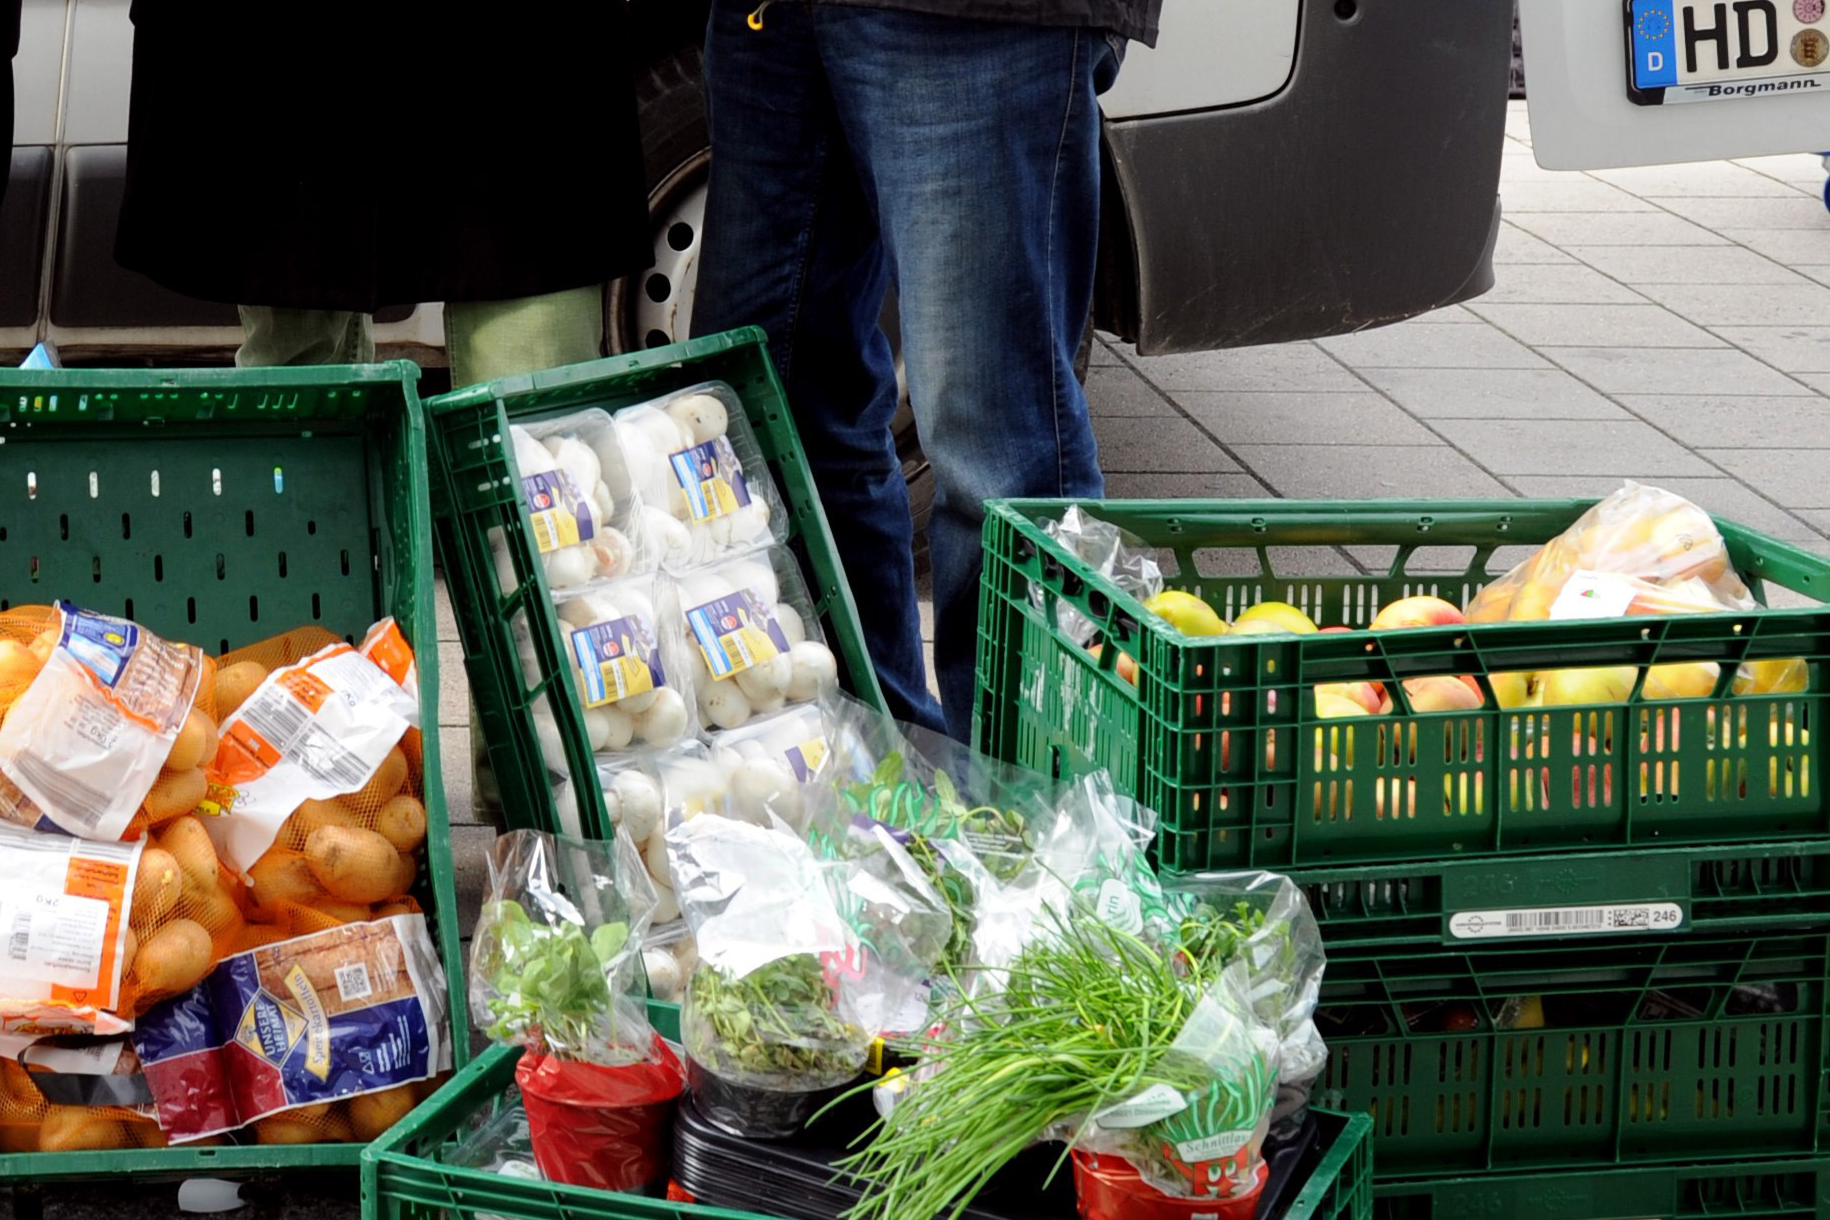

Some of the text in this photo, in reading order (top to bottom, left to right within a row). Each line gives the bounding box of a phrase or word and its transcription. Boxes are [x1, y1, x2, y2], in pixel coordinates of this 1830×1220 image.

[1647, 51, 1664, 72] D
[1707, 79, 1821, 97] Borgmann
[1652, 909, 1678, 924] 246
[254, 1001, 276, 1057] UNSERE
[265, 1003, 288, 1054] HEIMAT
